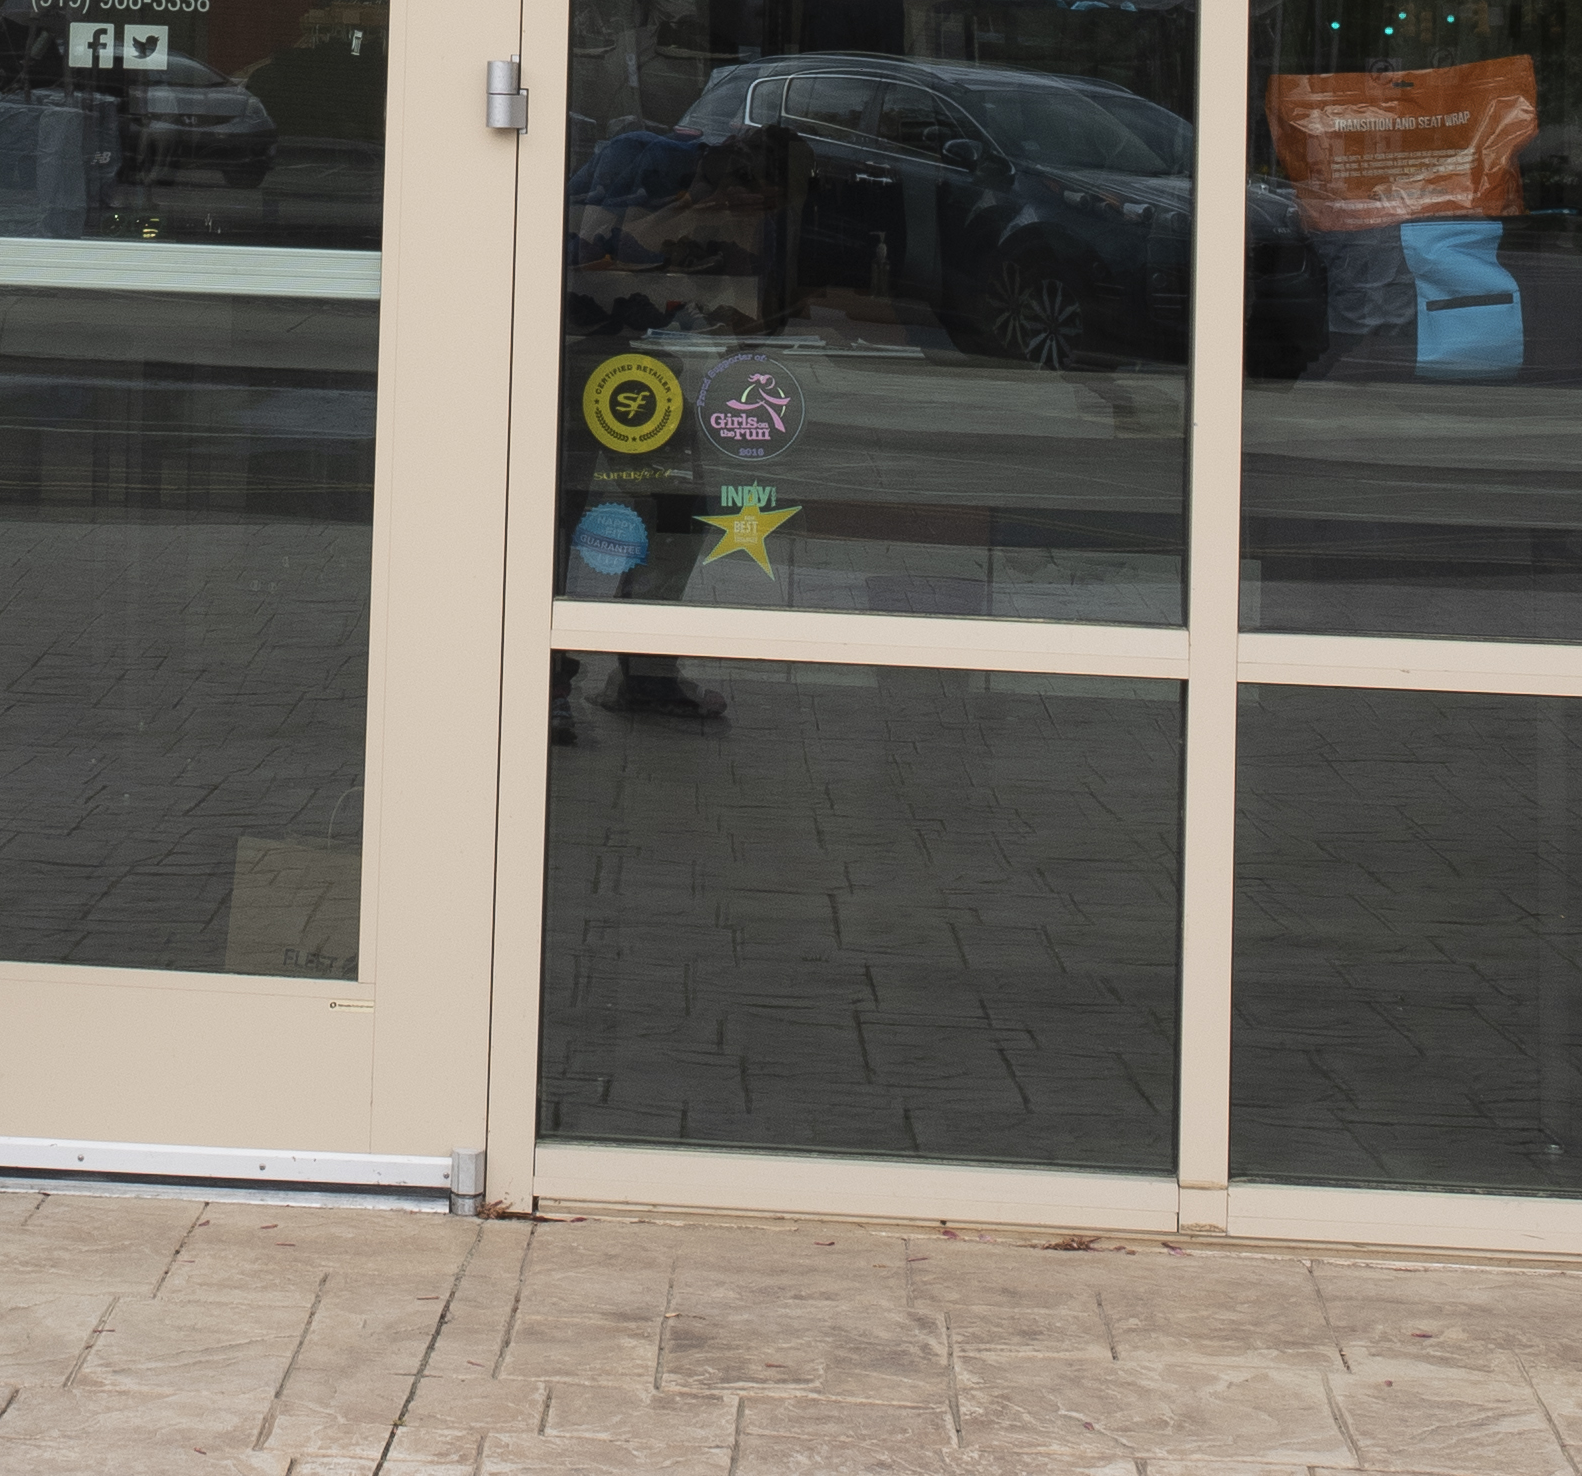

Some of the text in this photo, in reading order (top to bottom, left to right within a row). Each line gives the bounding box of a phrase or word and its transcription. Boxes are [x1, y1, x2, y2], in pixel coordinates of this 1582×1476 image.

[1334, 110, 1471, 132] TRANSITION AND SEAT WRAP
[595, 364, 672, 395] CERTIFIED RETAILER
[710, 412, 758, 429] Girls
[734, 428, 771, 440] run
[720, 485, 772, 508] INDY
[733, 520, 759, 533] BEST
[579, 533, 642, 556] GUARANTEE
